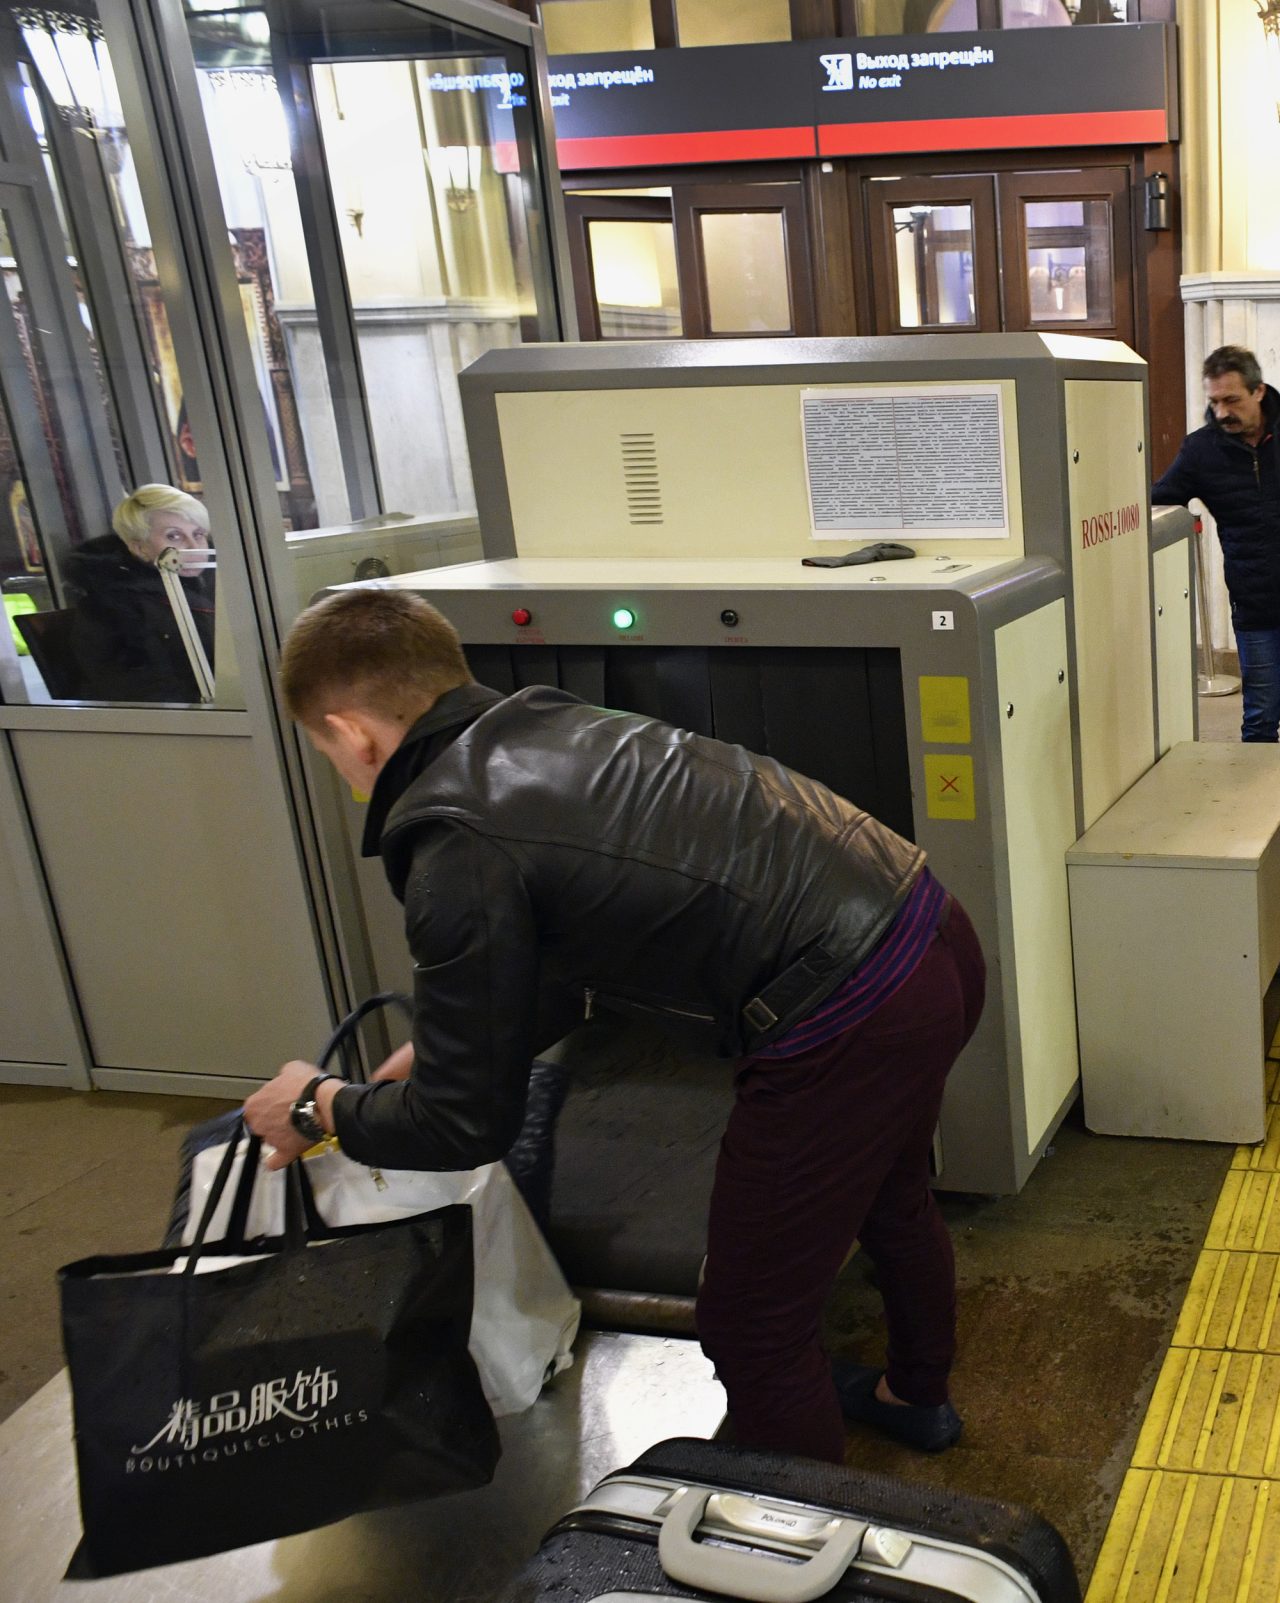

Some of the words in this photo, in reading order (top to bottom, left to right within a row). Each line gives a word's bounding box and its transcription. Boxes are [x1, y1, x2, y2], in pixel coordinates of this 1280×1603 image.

[856, 52, 910, 70] Выход
[910, 46, 994, 69] запрещён
[548, 73, 577, 90] ход
[577, 65, 655, 89] запрещён
[858, 75, 877, 89] No
[878, 74, 902, 88] exit
[1081, 503, 1140, 549] ROSSI-10080
[939, 615, 948, 627] 2
[131, 1366, 339, 1454] 精品服饰
